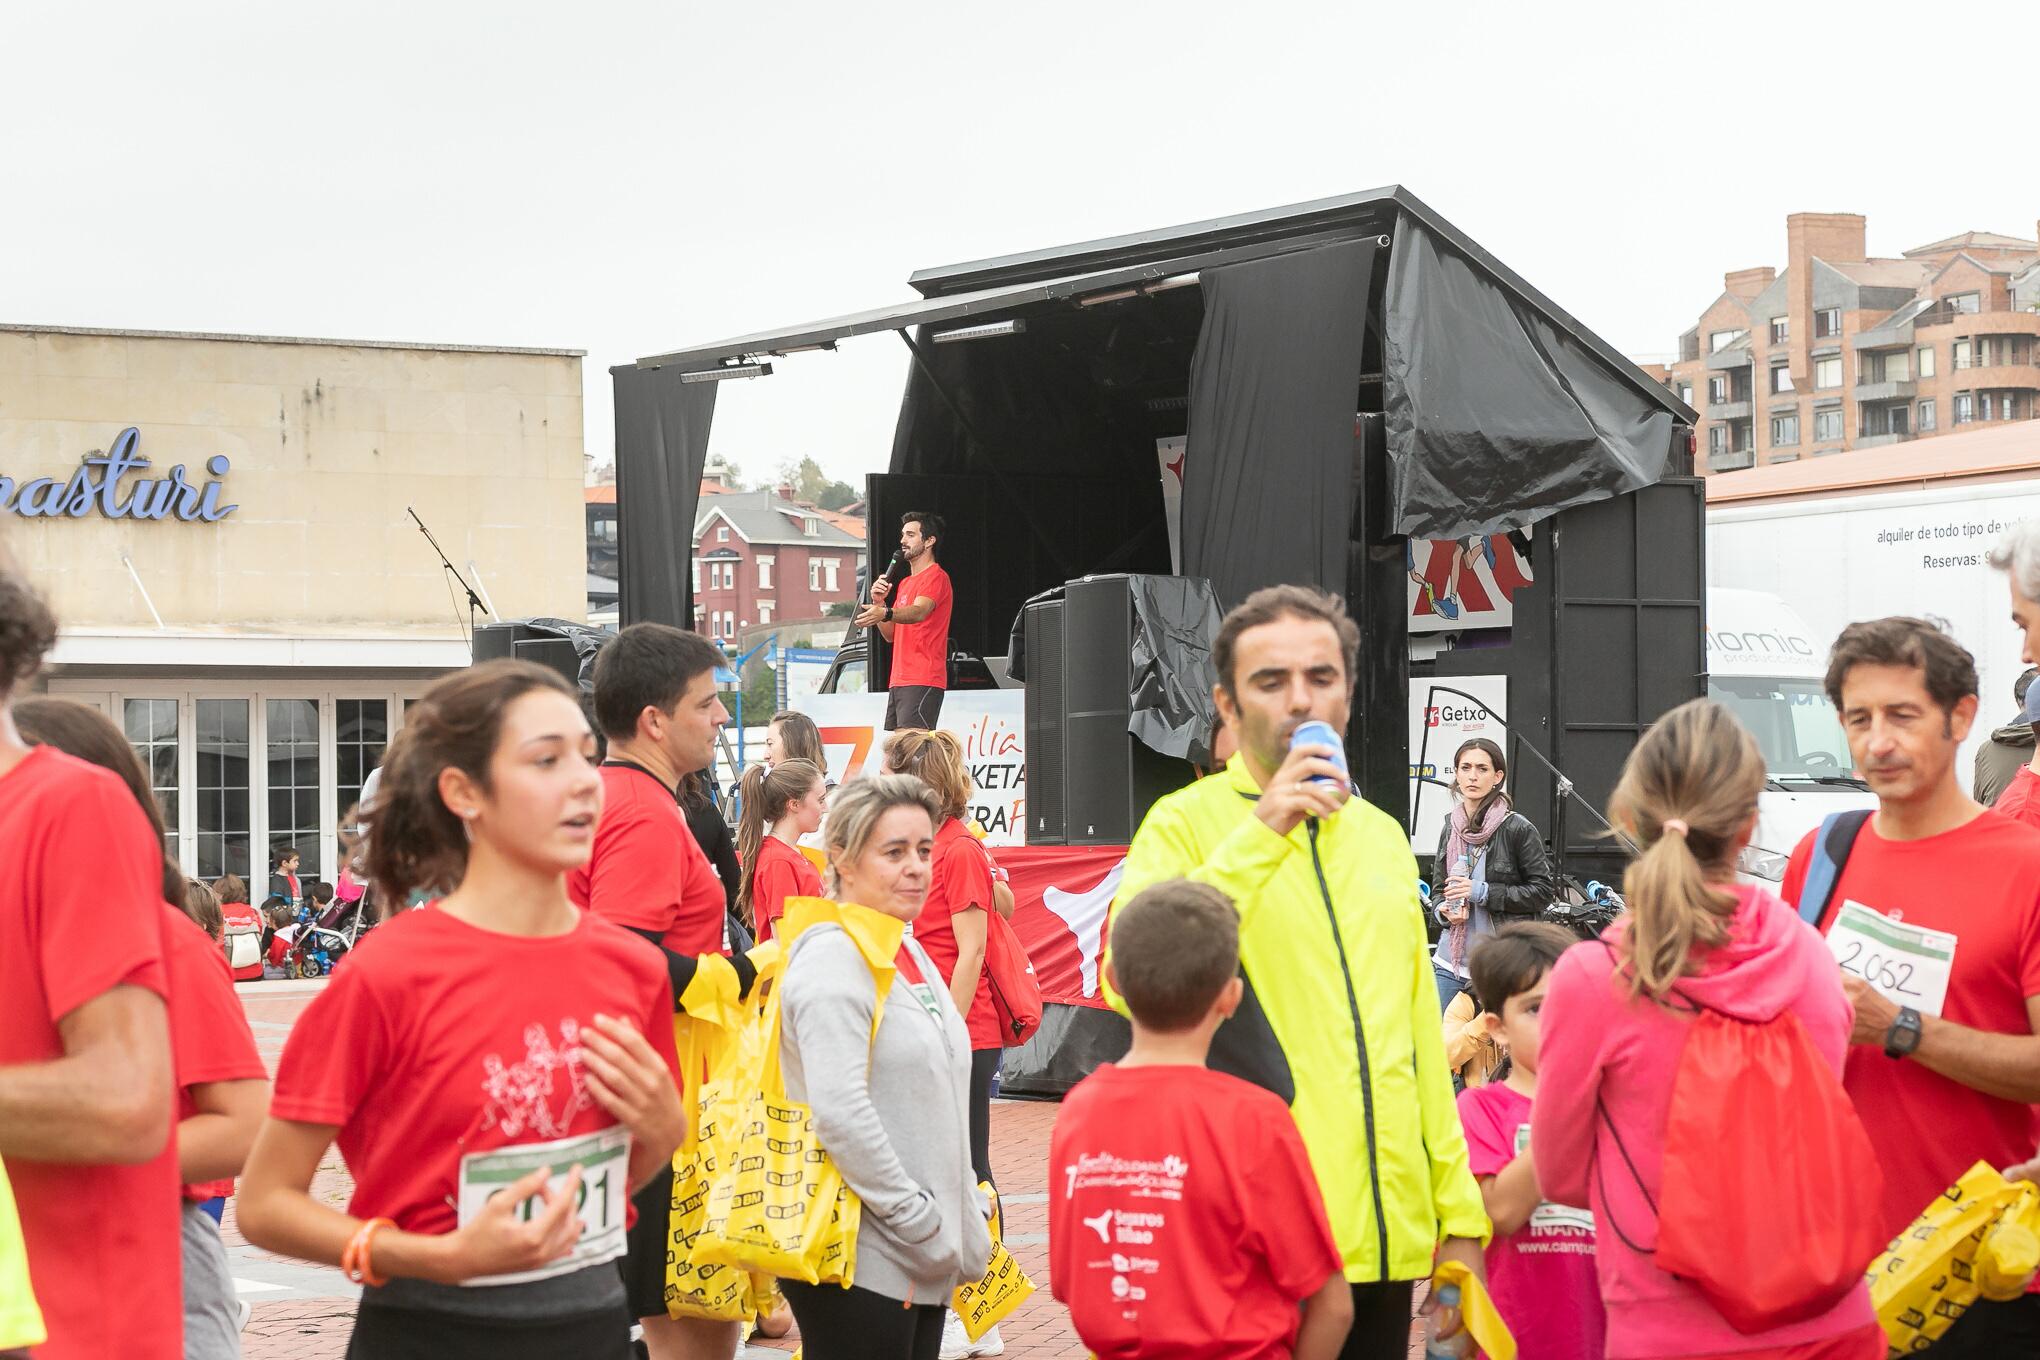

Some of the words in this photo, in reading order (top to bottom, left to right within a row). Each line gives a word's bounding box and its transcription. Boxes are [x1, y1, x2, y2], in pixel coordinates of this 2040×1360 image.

[1877, 528, 1914, 546] alquiler
[1918, 526, 1931, 540] de
[1934, 523, 1959, 539] todo
[1963, 522, 1984, 539] tipo
[1987, 519, 2001, 534] de
[1923, 554, 1981, 569] Reservas:
[1706, 626, 1813, 656] iomic
[1442, 706, 1487, 721] Getxo
[967, 715, 1023, 760] ilia
[966, 764, 1026, 790] KETA
